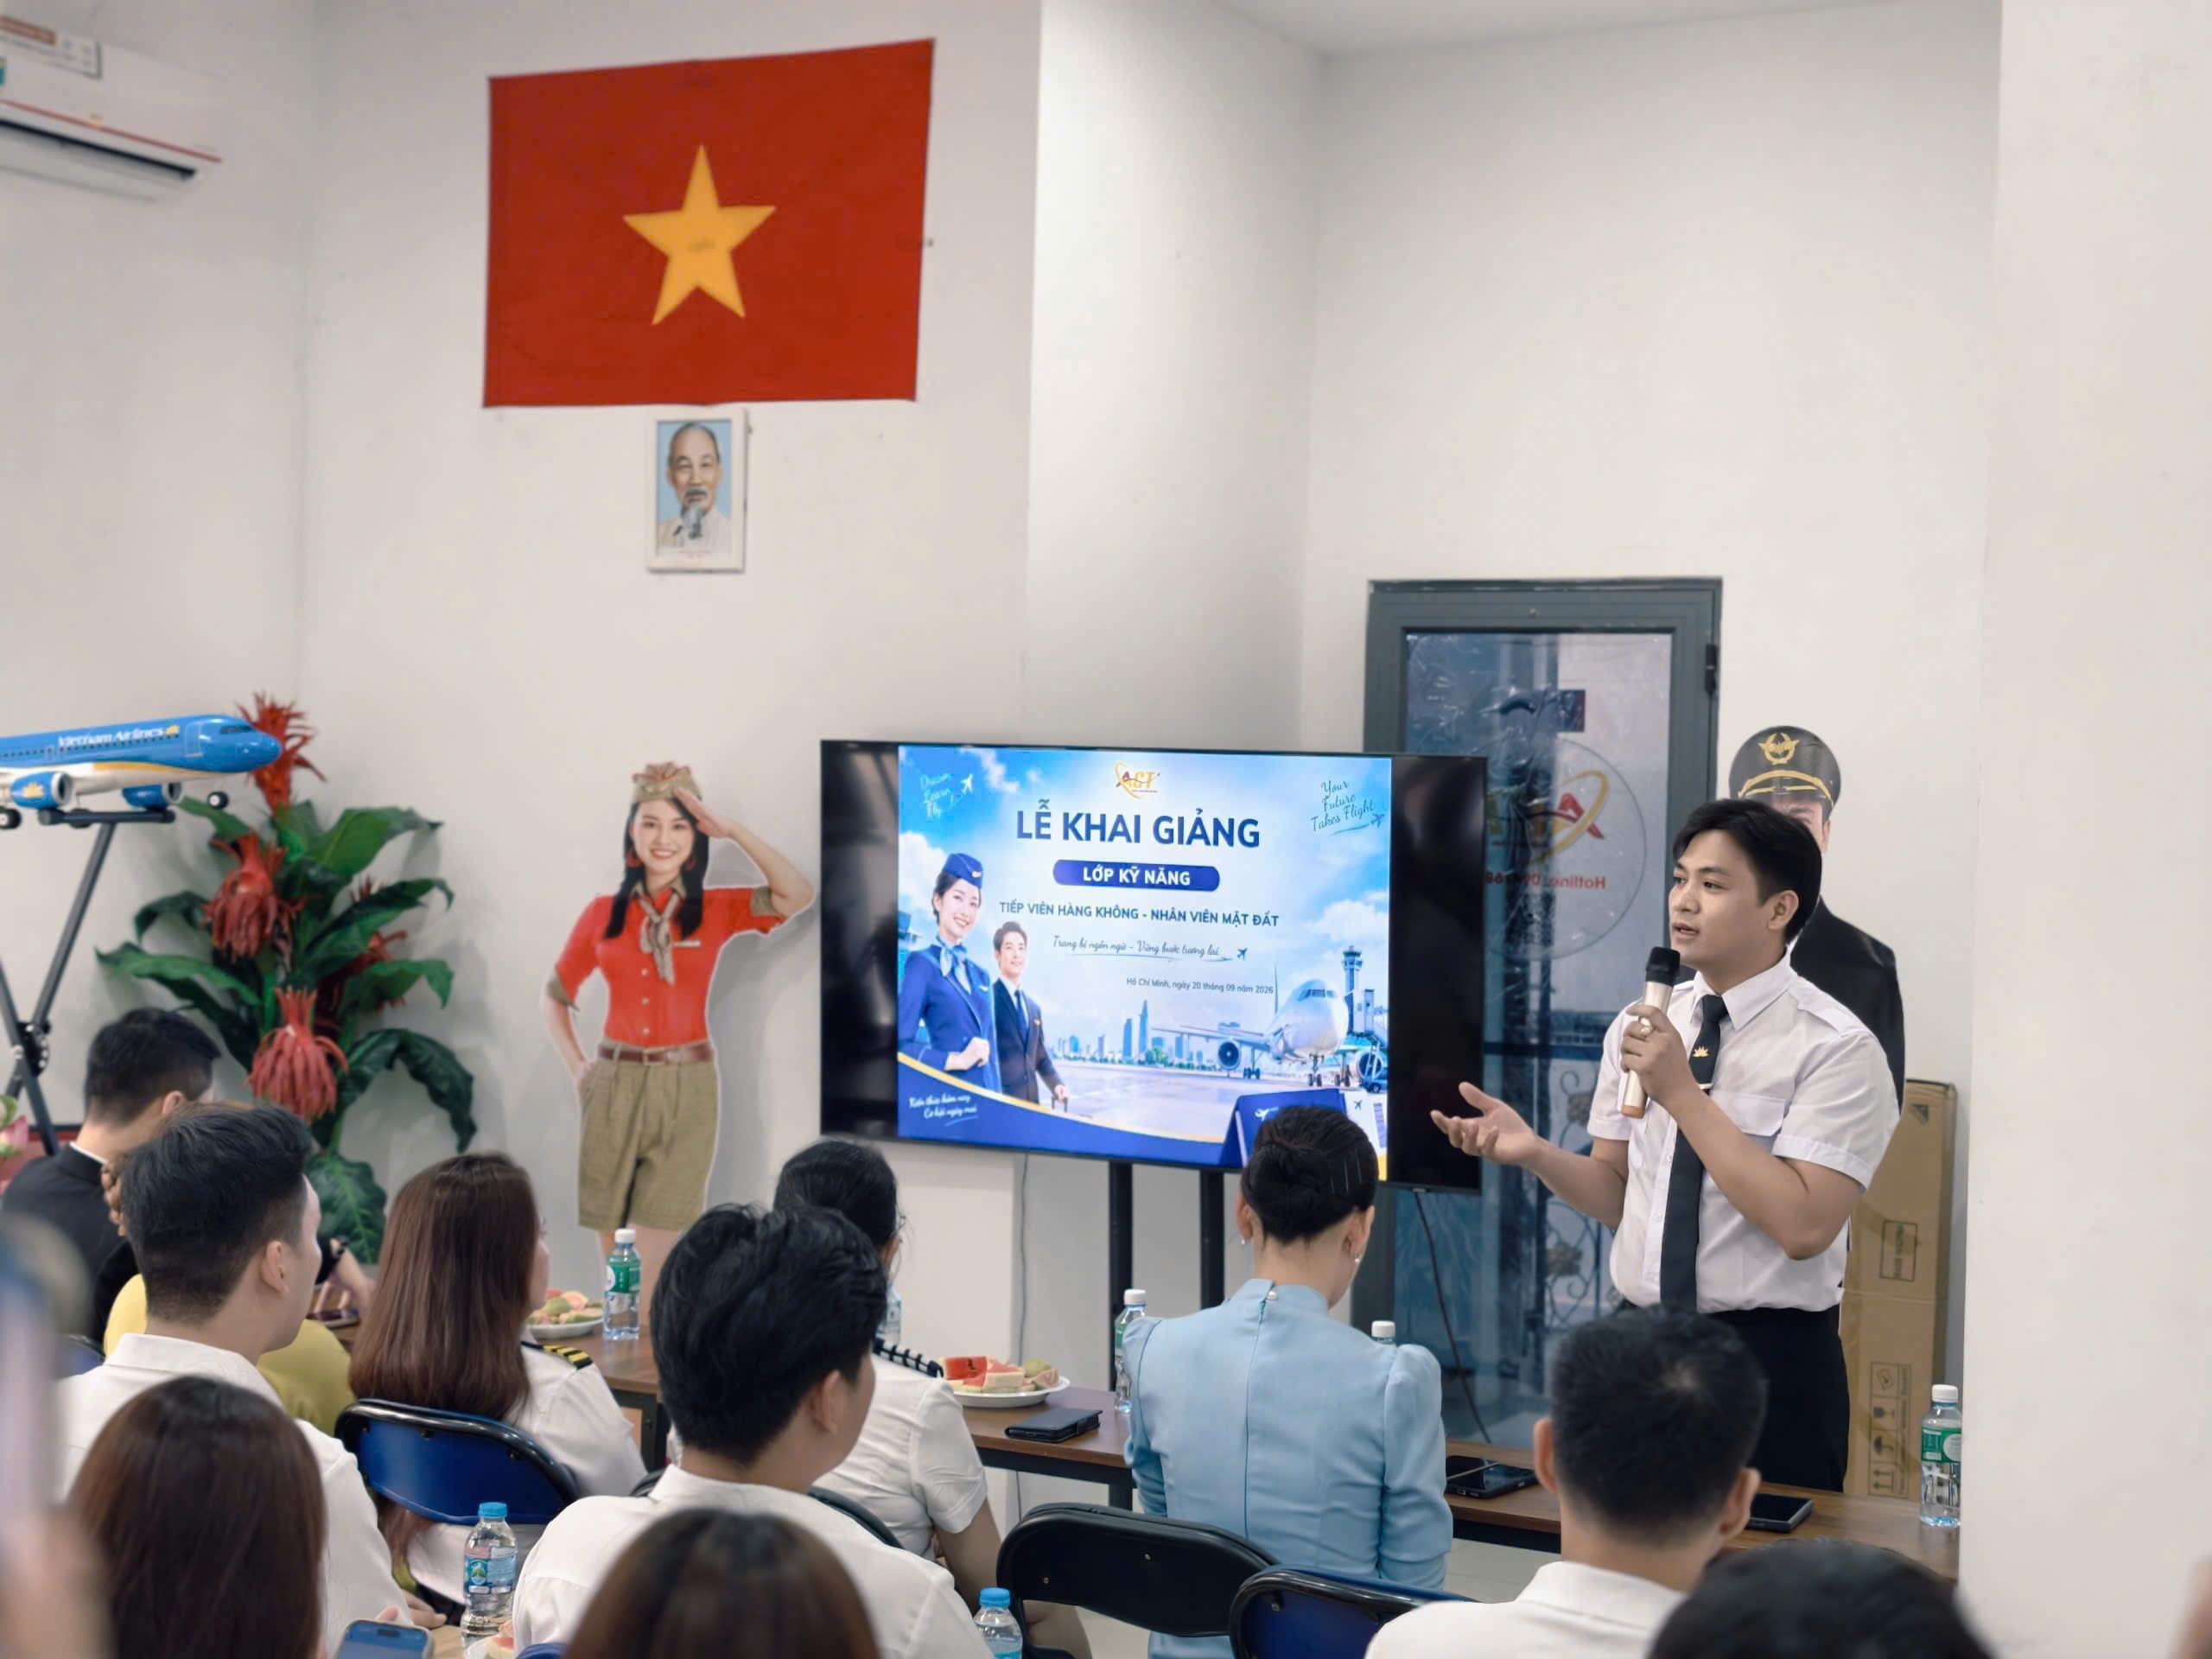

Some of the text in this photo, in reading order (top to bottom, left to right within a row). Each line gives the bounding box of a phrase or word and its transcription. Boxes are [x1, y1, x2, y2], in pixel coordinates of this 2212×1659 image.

[1320, 779, 1349, 796] Your
[1321, 794, 1356, 813] Future
[1017, 798, 1261, 849] LỄ KHAI GIẢNG
[1310, 798, 1375, 832] Takes Flight
[1083, 864, 1192, 887] LỚP KỸ NĂNG
[999, 899, 1025, 913] TIẾP
[1027, 900, 1055, 916] VIÊN
[1057, 902, 1093, 918] HÀNG
[1095, 904, 1140, 919] KHÔNG
[1150, 907, 1187, 923] NHÂN
[1190, 909, 1219, 924] VIÊN
[1222, 911, 1249, 928] MẶT
[1251, 911, 1280, 927] ĐẤT
[1052, 935, 1077, 951] Trang
[1206, 944, 1220, 956] lai
[1138, 977, 1151, 987] Chí
[1172, 981, 1191, 991] ngày
[1192, 981, 1202, 989] 20
[1203, 982, 1224, 993] tháng
[1225, 983, 1236, 992] 09
[1236, 984, 1254, 993] năm
[1255, 985, 1274, 995] 2026
